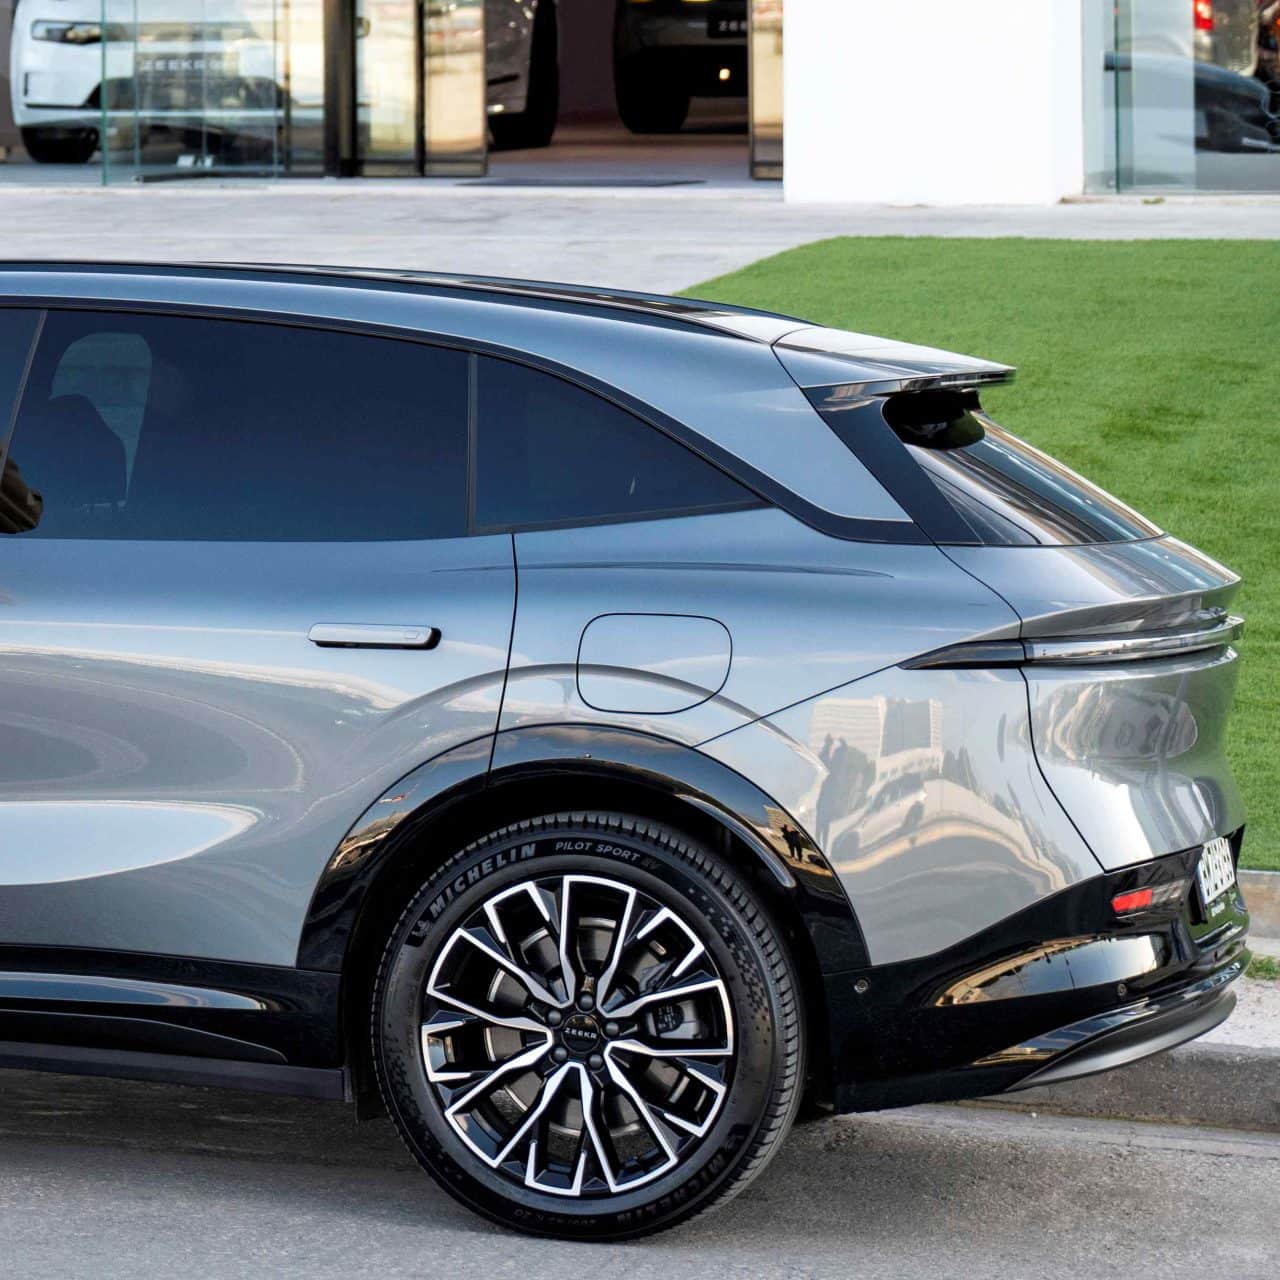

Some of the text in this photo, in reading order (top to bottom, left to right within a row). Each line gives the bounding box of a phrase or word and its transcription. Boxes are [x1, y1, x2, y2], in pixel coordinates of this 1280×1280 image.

[429, 843, 537, 919] MICHELIN
[555, 841, 594, 852] PILOT
[595, 843, 641, 861] SPORT
[564, 1027, 598, 1039] ZEEKR
